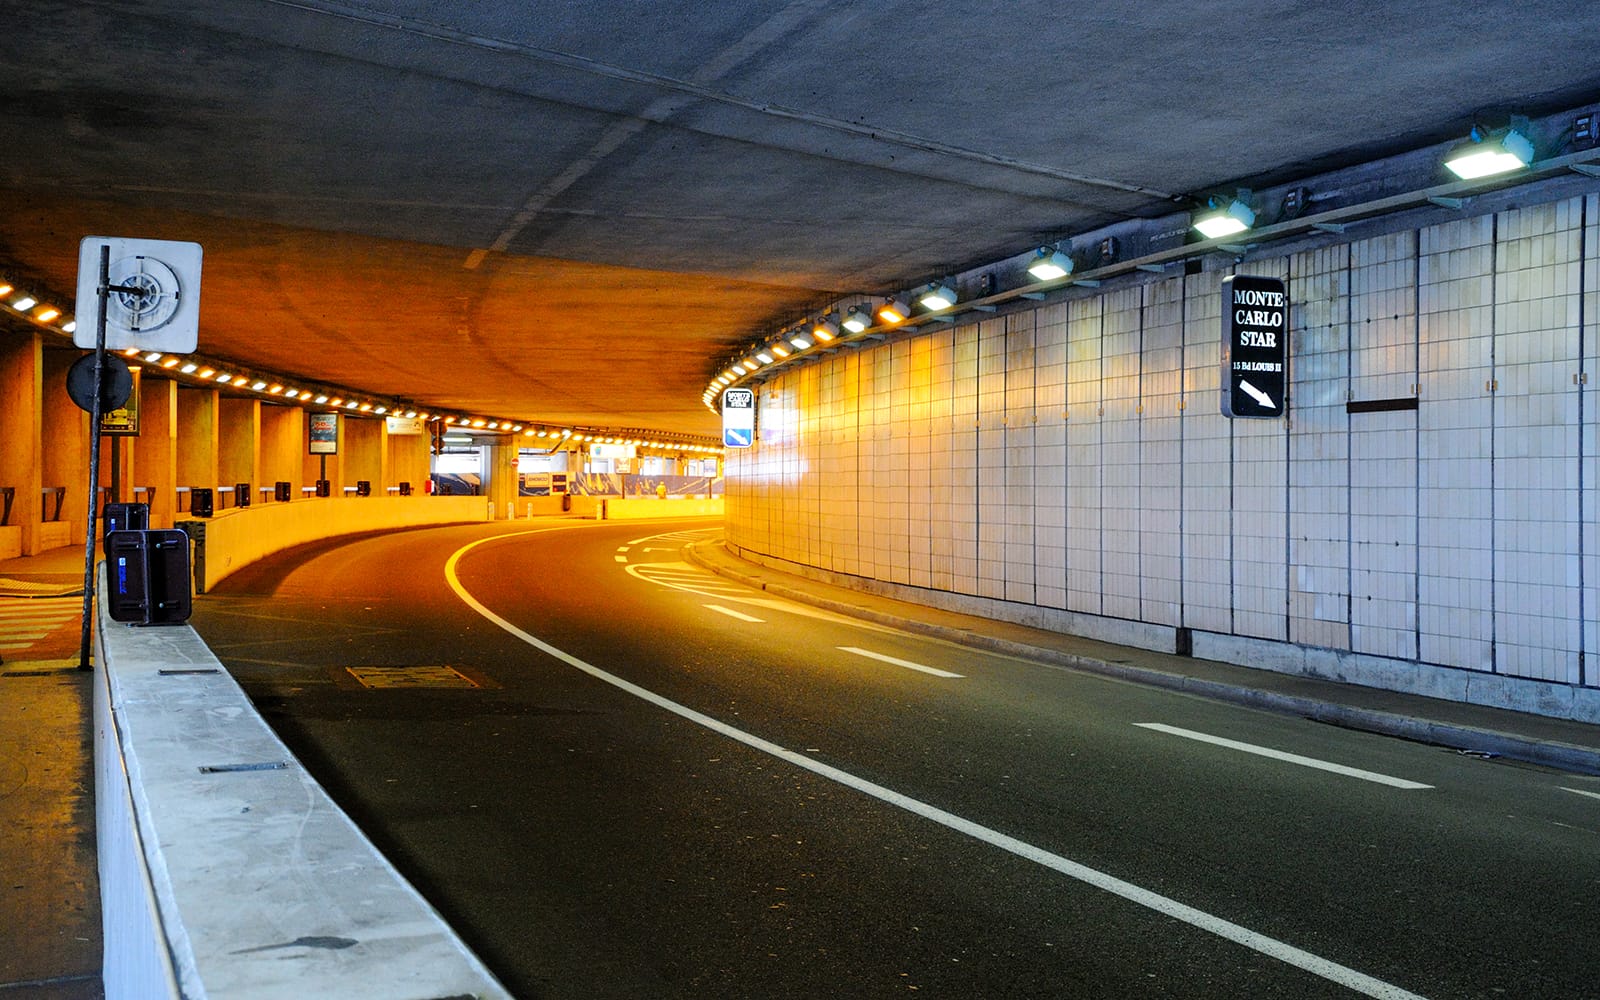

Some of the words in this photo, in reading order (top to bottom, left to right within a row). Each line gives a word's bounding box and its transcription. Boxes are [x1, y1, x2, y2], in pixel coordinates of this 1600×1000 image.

[1234, 290, 1283, 307] MONTE
[1236, 310, 1282, 327] CARLO
[1240, 331, 1276, 347] STAR
[1233, 361, 1240, 370] 15
[1241, 361, 1251, 371] Bd
[1252, 362, 1274, 371] LOUIS
[1275, 363, 1282, 372] II
